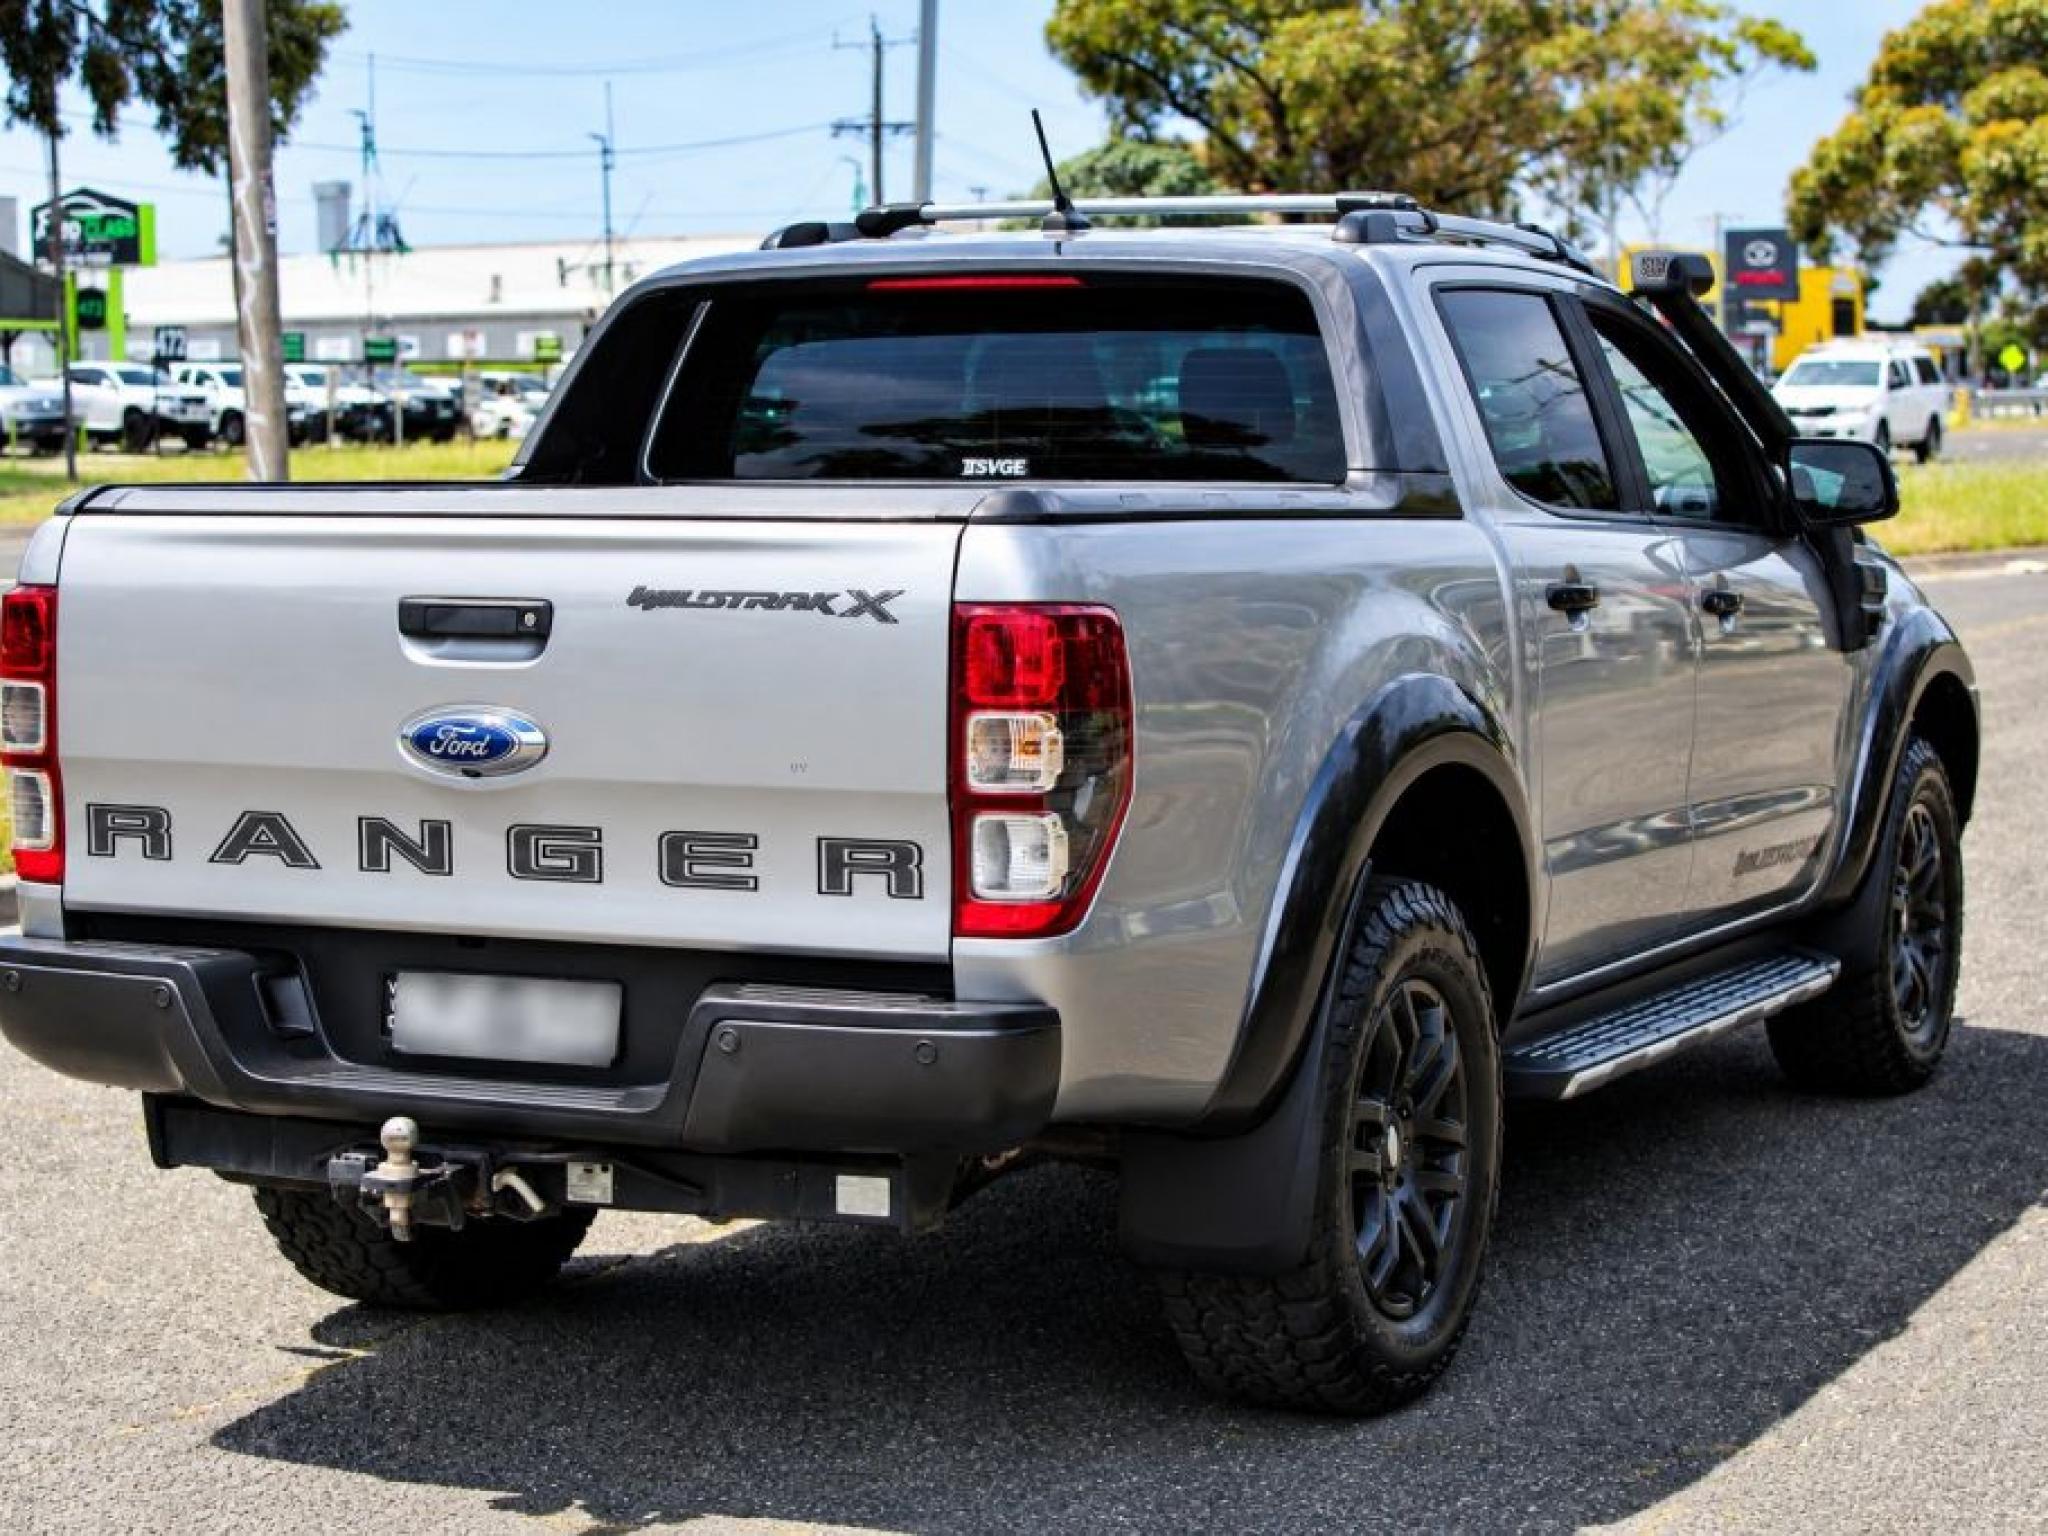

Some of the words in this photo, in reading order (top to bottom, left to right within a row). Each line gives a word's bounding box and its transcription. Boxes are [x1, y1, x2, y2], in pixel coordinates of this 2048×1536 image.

[626, 585, 840, 616] WILDTRAK
[838, 590, 906, 624] X
[429, 725, 491, 756] Ford
[86, 803, 925, 900] RANGER
